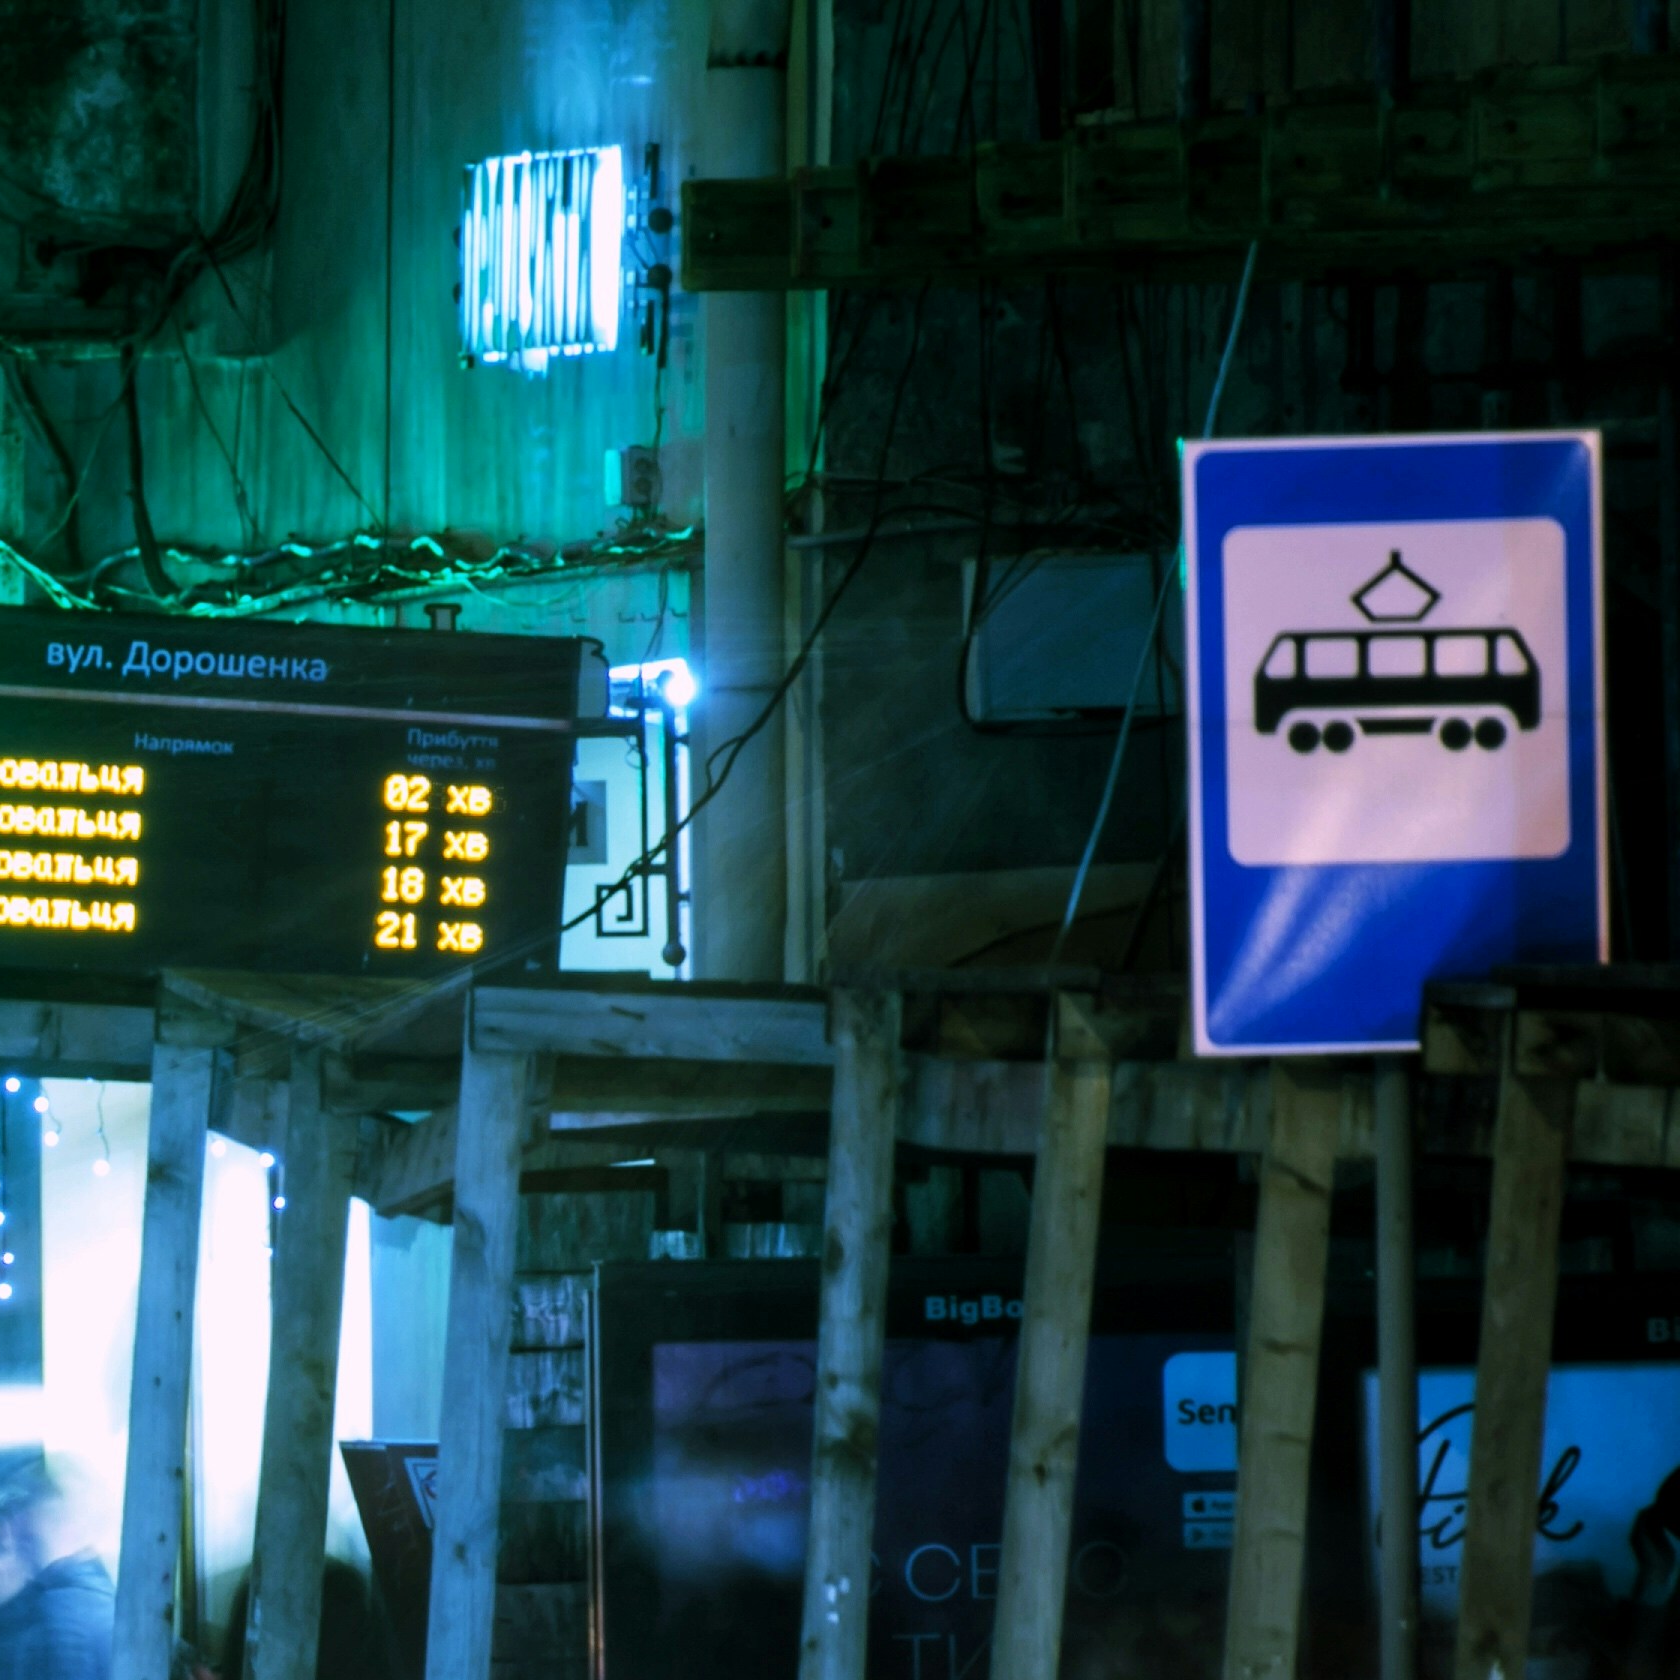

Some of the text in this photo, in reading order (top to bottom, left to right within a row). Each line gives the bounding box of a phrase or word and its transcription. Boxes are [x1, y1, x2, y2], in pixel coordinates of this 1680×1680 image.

[46, 640, 329, 682] вул. Дорошенка
[134, 733, 234, 755] Напрямок
[407, 728, 499, 749] Прибуття
[383, 773, 432, 813] 02
[446, 785, 492, 816] хв
[384, 820, 430, 857] 17
[443, 831, 489, 862] хв
[381, 866, 426, 904] 18
[440, 876, 486, 907] хв
[375, 911, 418, 949] 21
[437, 921, 484, 952] хв
[924, 1294, 1025, 1327] BigBo
[1177, 1398, 1237, 1425] Sen
